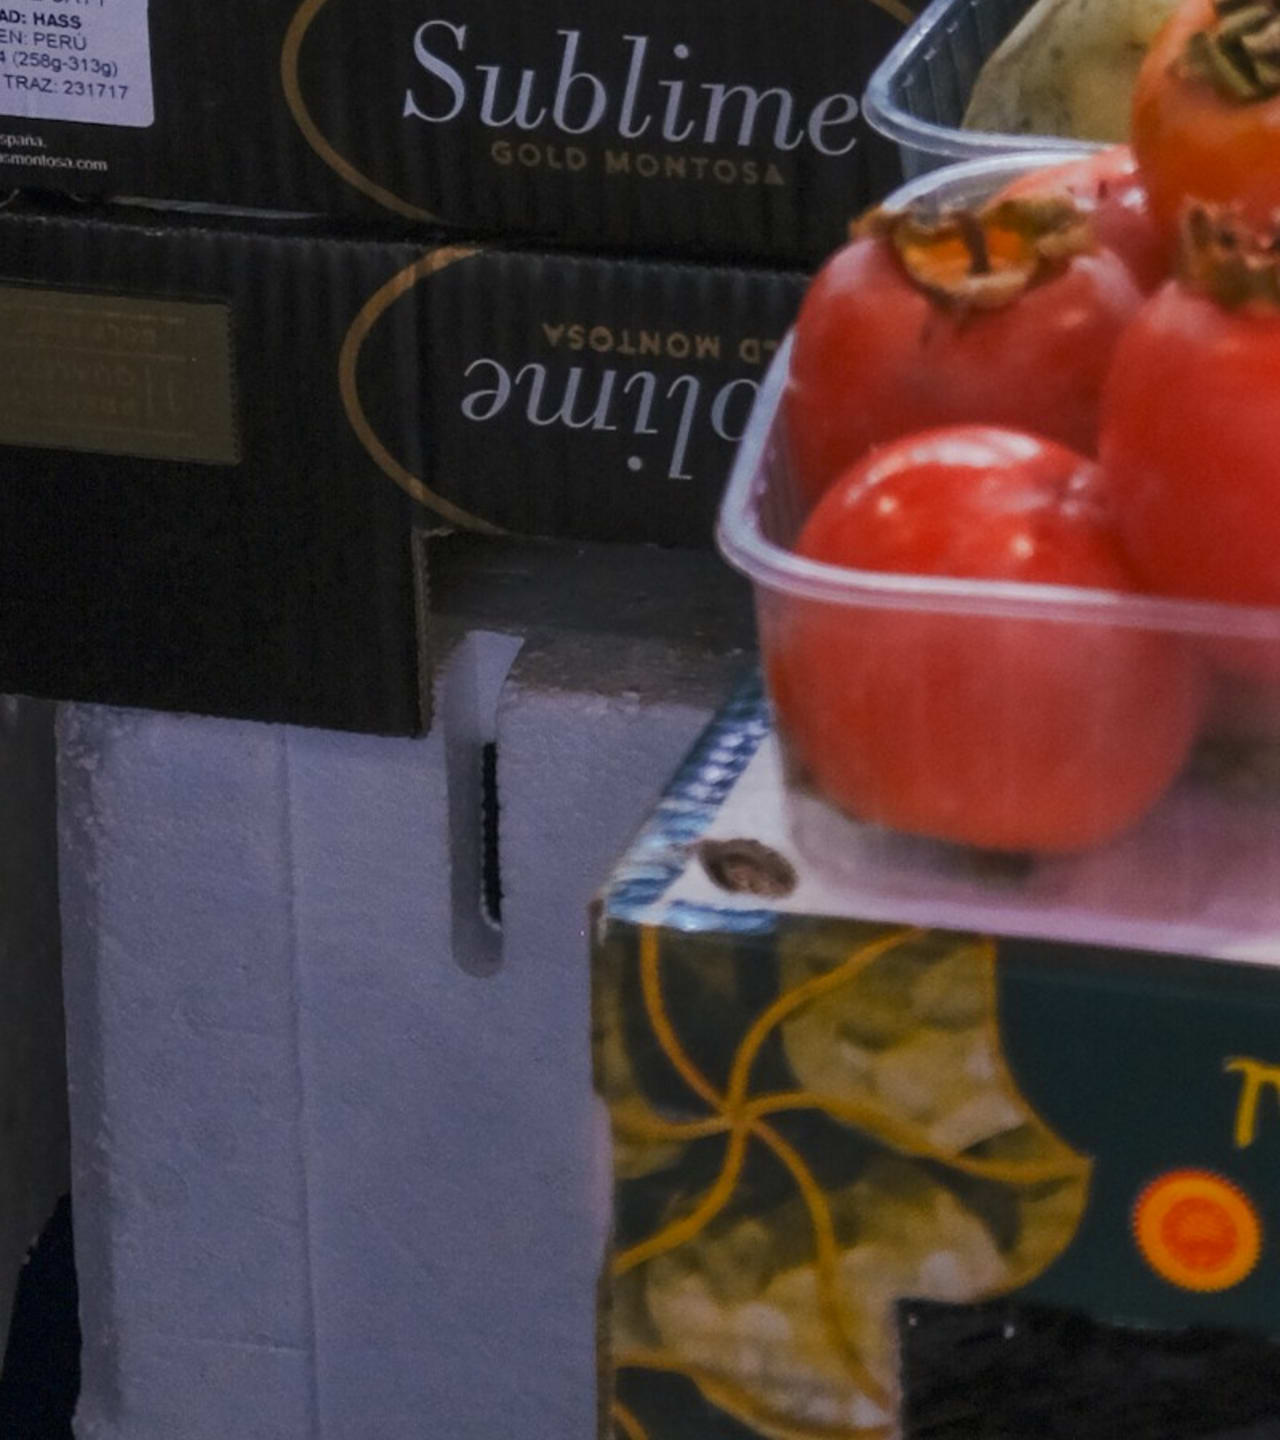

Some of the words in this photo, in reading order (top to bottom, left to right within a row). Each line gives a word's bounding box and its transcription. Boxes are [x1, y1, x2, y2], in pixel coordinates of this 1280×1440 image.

[33, 11, 82, 30] HASS
[33, 31, 87, 52] PERÚ
[13, 51, 118, 78] (258g-313g)
[4, 73, 58, 94] TRAZ:
[63, 80, 129, 100] 231717
[403, 18, 864, 156] Sublime
[490, 139, 588, 172] GOLD
[605, 143, 785, 186] MONTOSA
[542, 321, 721, 359] MONTOSA
